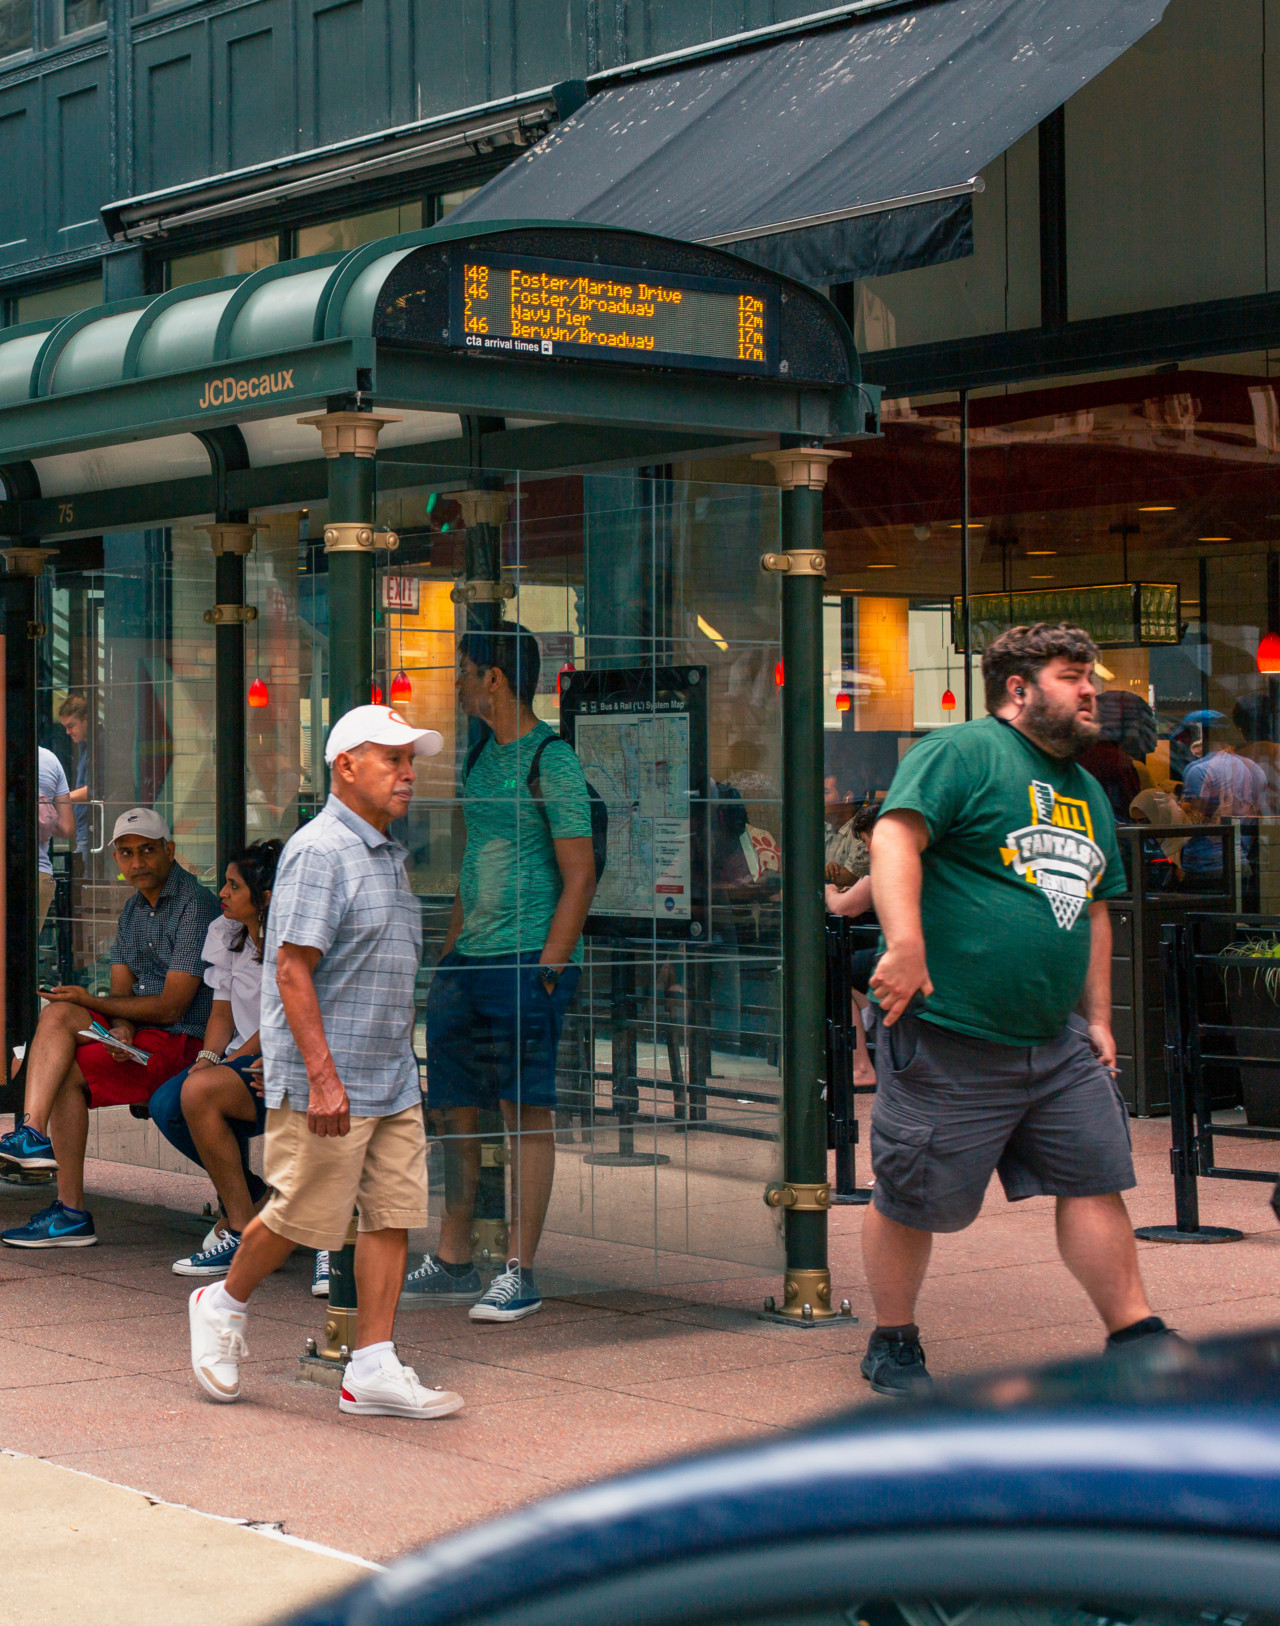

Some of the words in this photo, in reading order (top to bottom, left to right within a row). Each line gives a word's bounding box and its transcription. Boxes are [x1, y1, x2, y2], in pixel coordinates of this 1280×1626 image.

[511, 269, 633, 298] Foster/Marine
[638, 283, 682, 303] Drive
[738, 295, 764, 312] 12m
[511, 287, 655, 317] Foster/Broadway
[738, 311, 764, 328] 12m
[511, 303, 551, 323] Navy
[556, 308, 592, 326] Pier
[738, 327, 764, 344] 17m
[511, 320, 655, 350] Berwyn/Broadway
[738, 343, 764, 361] 17m
[466, 335, 481, 347] cta
[484, 338, 512, 349] arrival
[514, 340, 539, 352] times
[199, 369, 295, 408] JCDecaux
[58, 504, 74, 523] 75
[387, 576, 413, 601] EXIT
[600, 702, 612, 711] Bus
[620, 702, 632, 710] Rail
[671, 700, 685, 711] Map
